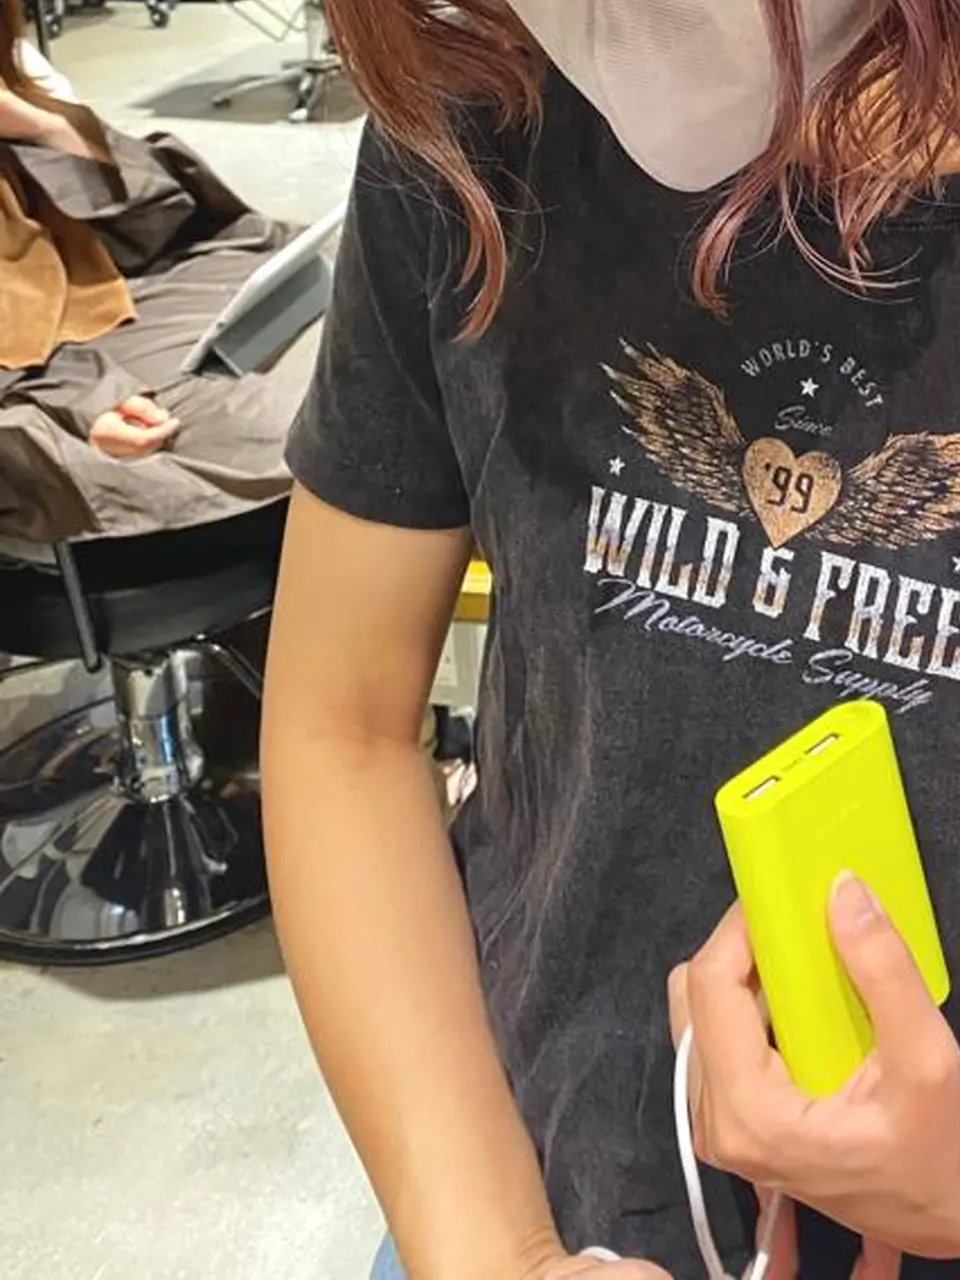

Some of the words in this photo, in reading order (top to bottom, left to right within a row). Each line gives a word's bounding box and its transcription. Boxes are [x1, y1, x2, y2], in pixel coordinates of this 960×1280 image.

[740, 339, 833, 377] WORLD'S
[840, 357, 884, 407] BEST
[764, 462, 815, 513] '99
[584, 486, 741, 609] WILD
[594, 578, 794, 665] Motorcycle
[801, 649, 933, 713] Supply
